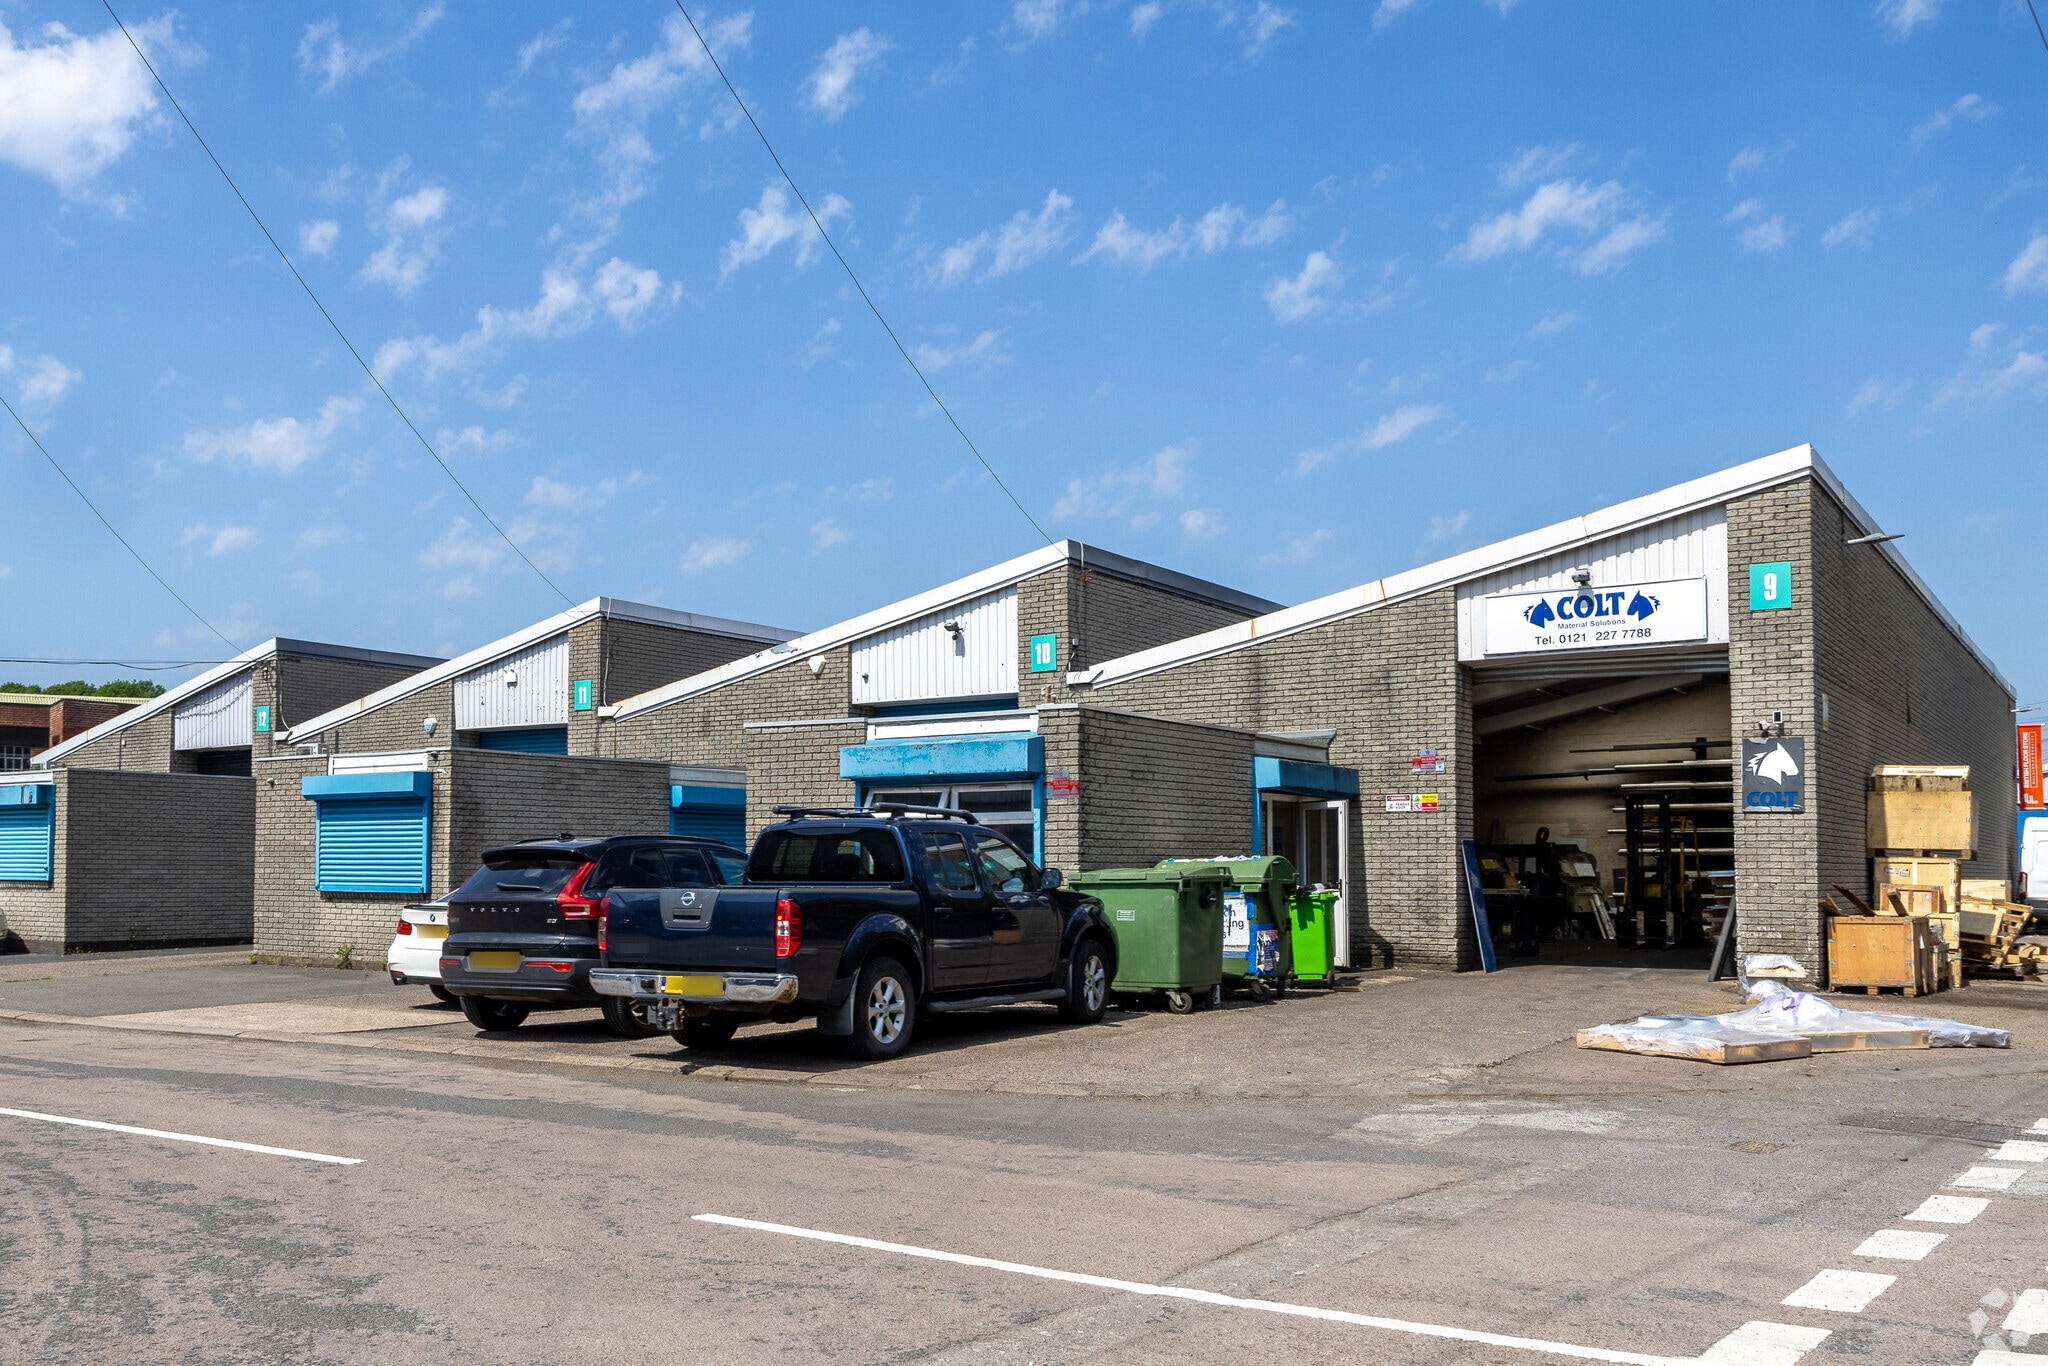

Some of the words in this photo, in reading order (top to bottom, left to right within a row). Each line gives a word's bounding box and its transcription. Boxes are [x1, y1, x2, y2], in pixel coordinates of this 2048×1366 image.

[1763, 572, 1777, 601] 9
[1556, 592, 1625, 620] COLT
[1557, 621, 1588, 630] Material
[1590, 619, 1626, 627] Solutions
[1535, 635, 1555, 645] Tel.
[1559, 633, 1586, 643] 0121
[1595, 630, 1617, 641] 227
[1621, 627, 1652, 639] 7788
[1035, 642, 1051, 665] 10
[578, 686, 587, 704] 11
[258, 711, 267, 727] 12
[1747, 791, 1799, 808] COLT
